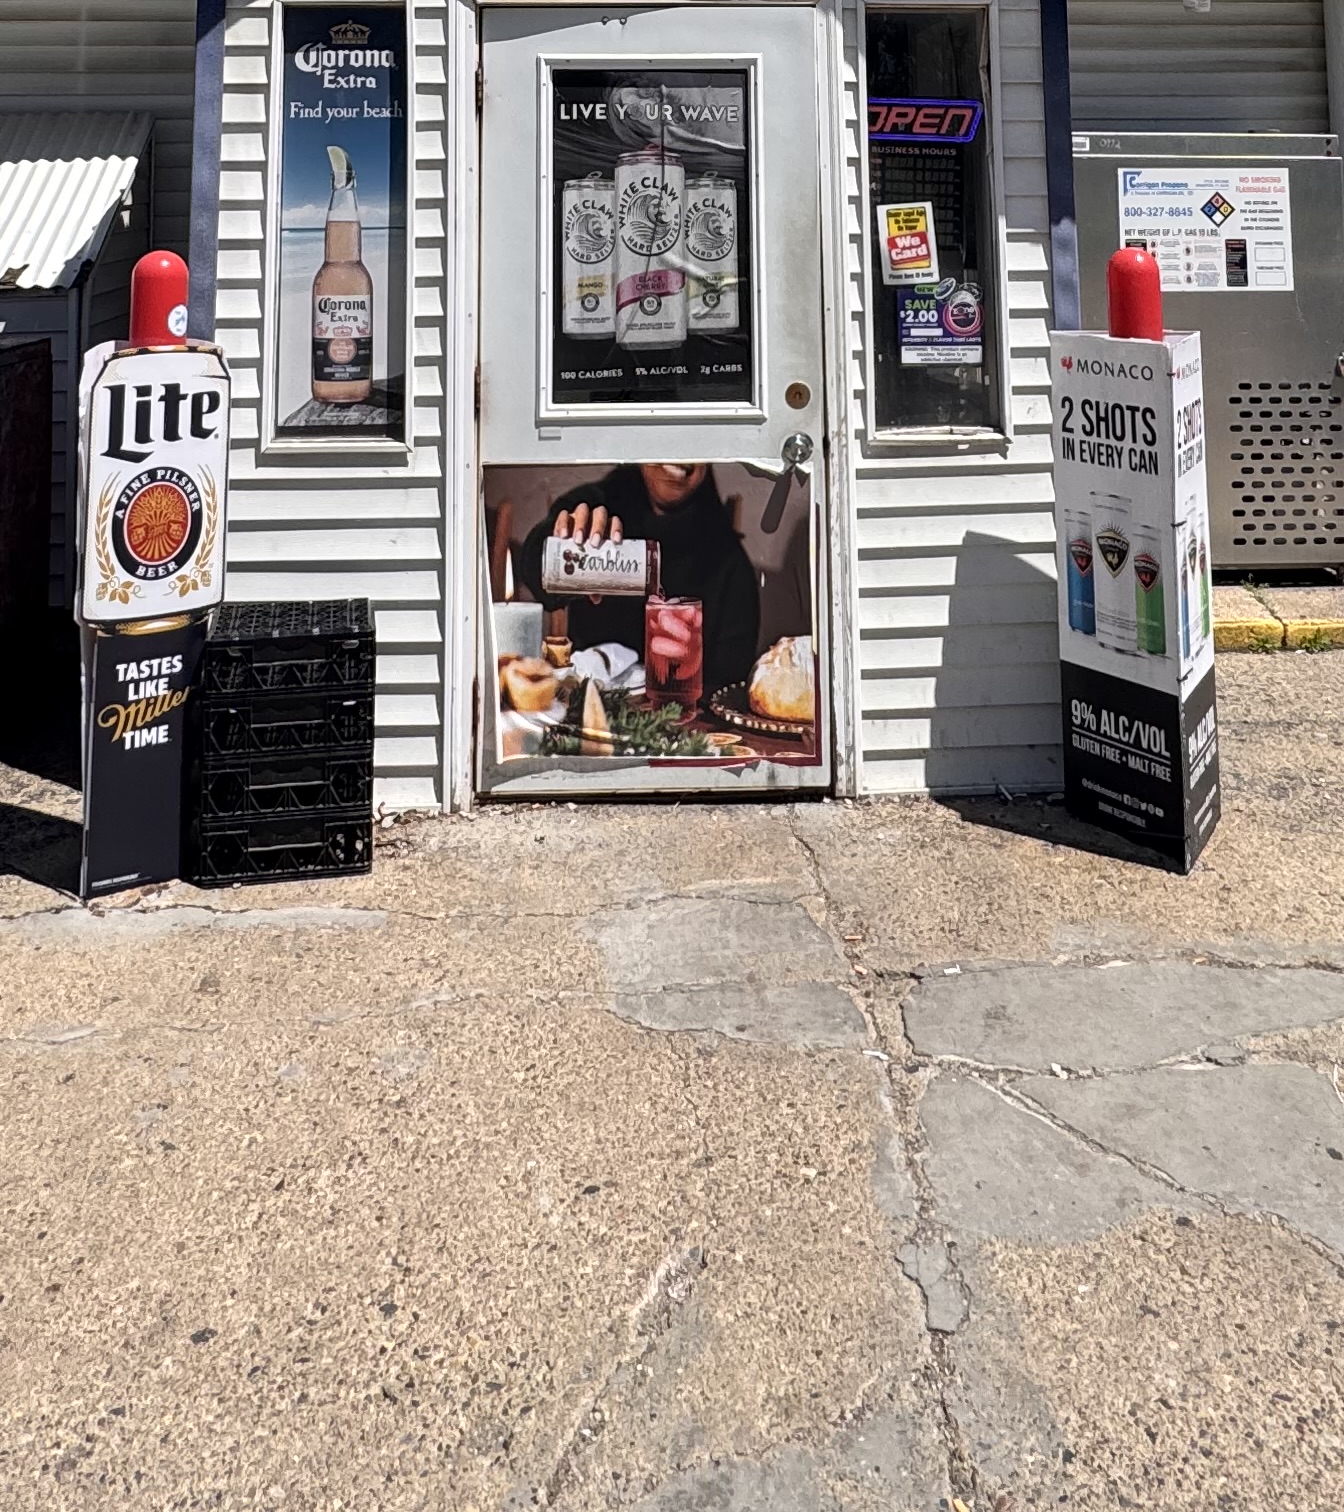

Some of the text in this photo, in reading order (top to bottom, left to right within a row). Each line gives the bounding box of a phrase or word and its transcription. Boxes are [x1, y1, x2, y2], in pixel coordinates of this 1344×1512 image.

[295, 42, 395, 75] Corona
[323, 69, 377, 88] Extra
[289, 100, 403, 124] Find your beach
[560, 104, 607, 120] LIVE
[681, 105, 739, 122] WAVE
[872, 146, 957, 156] BUSINESS HOURS
[582, 199, 614, 220] CLAW
[619, 177, 679, 229] WHITE CLAW
[702, 198, 732, 218] CLAW
[895, 235, 921, 248] We
[891, 244, 928, 261] Card
[318, 297, 367, 315] Corona
[904, 299, 936, 309] SAVE
[330, 312, 358, 323] Extra
[899, 310, 938, 323] $2.00
[560, 369, 624, 380] 100 CALORIES
[650, 365, 688, 375] ALC/VOL
[712, 364, 743, 373] CARBS
[1076, 358, 1154, 381] MONACO
[100, 382, 221, 464] Lite
[1061, 396, 1157, 447] 2 SHOTS
[1062, 436, 1159, 476] IN EVERY CAN
[115, 469, 201, 519] A FINE PILSNER
[135, 560, 178, 578] BEER
[115, 654, 183, 683] TASTES
[127, 677, 170, 701] LIKE
[97, 686, 191, 743] Miller
[122, 724, 169, 751] TIME
[1071, 699, 1171, 758] 9% ALC/VOL
[1071, 733, 1101, 756] GLUTEN
[1101, 744, 1121, 764] FREE
[1128, 753, 1149, 774] MALT
[1150, 763, 1172, 783] FREE
